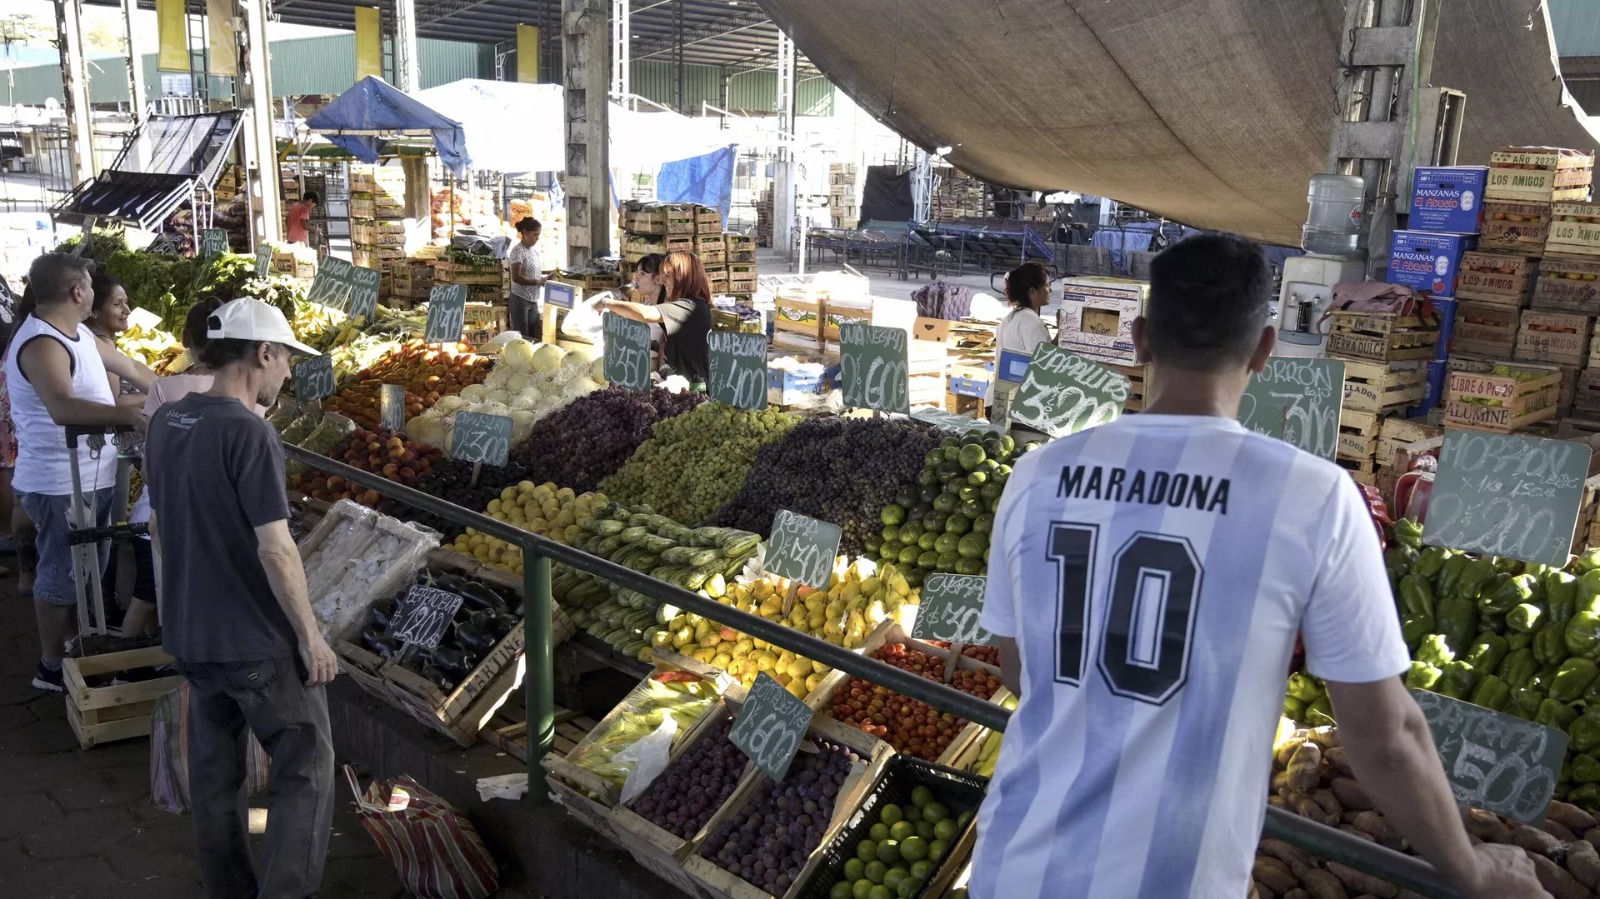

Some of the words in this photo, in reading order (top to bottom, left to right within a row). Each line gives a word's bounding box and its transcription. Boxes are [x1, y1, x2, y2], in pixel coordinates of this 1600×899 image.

[1491, 174, 1508, 185] LOS
[1512, 175, 1545, 188] AMIGOS
[1416, 189, 1460, 198] MANZANAS
[1487, 224, 1504, 235] LOS
[1556, 227, 1573, 239] LOS
[1577, 228, 1600, 240] AMIG
[1392, 251, 1435, 262] MANZANAS
[1463, 275, 1478, 286] LOS
[1482, 277, 1513, 290] AMIGOS
[1329, 334, 1357, 352] TIERRA
[1359, 339, 1385, 357] DULCE
[1541, 336, 1578, 350] MIGOS
[726, 359, 765, 409] 400
[864, 355, 909, 411] 600
[1451, 374, 1476, 394] LIBRE
[1478, 380, 1483, 394] 6
[1503, 383, 1514, 398] 29
[1340, 438, 1365, 454] ADOR
[1056, 465, 1231, 515] MARADONA
[1045, 520, 1204, 707] 10
[749, 713, 797, 773] 600
[1450, 734, 1557, 822] 500
